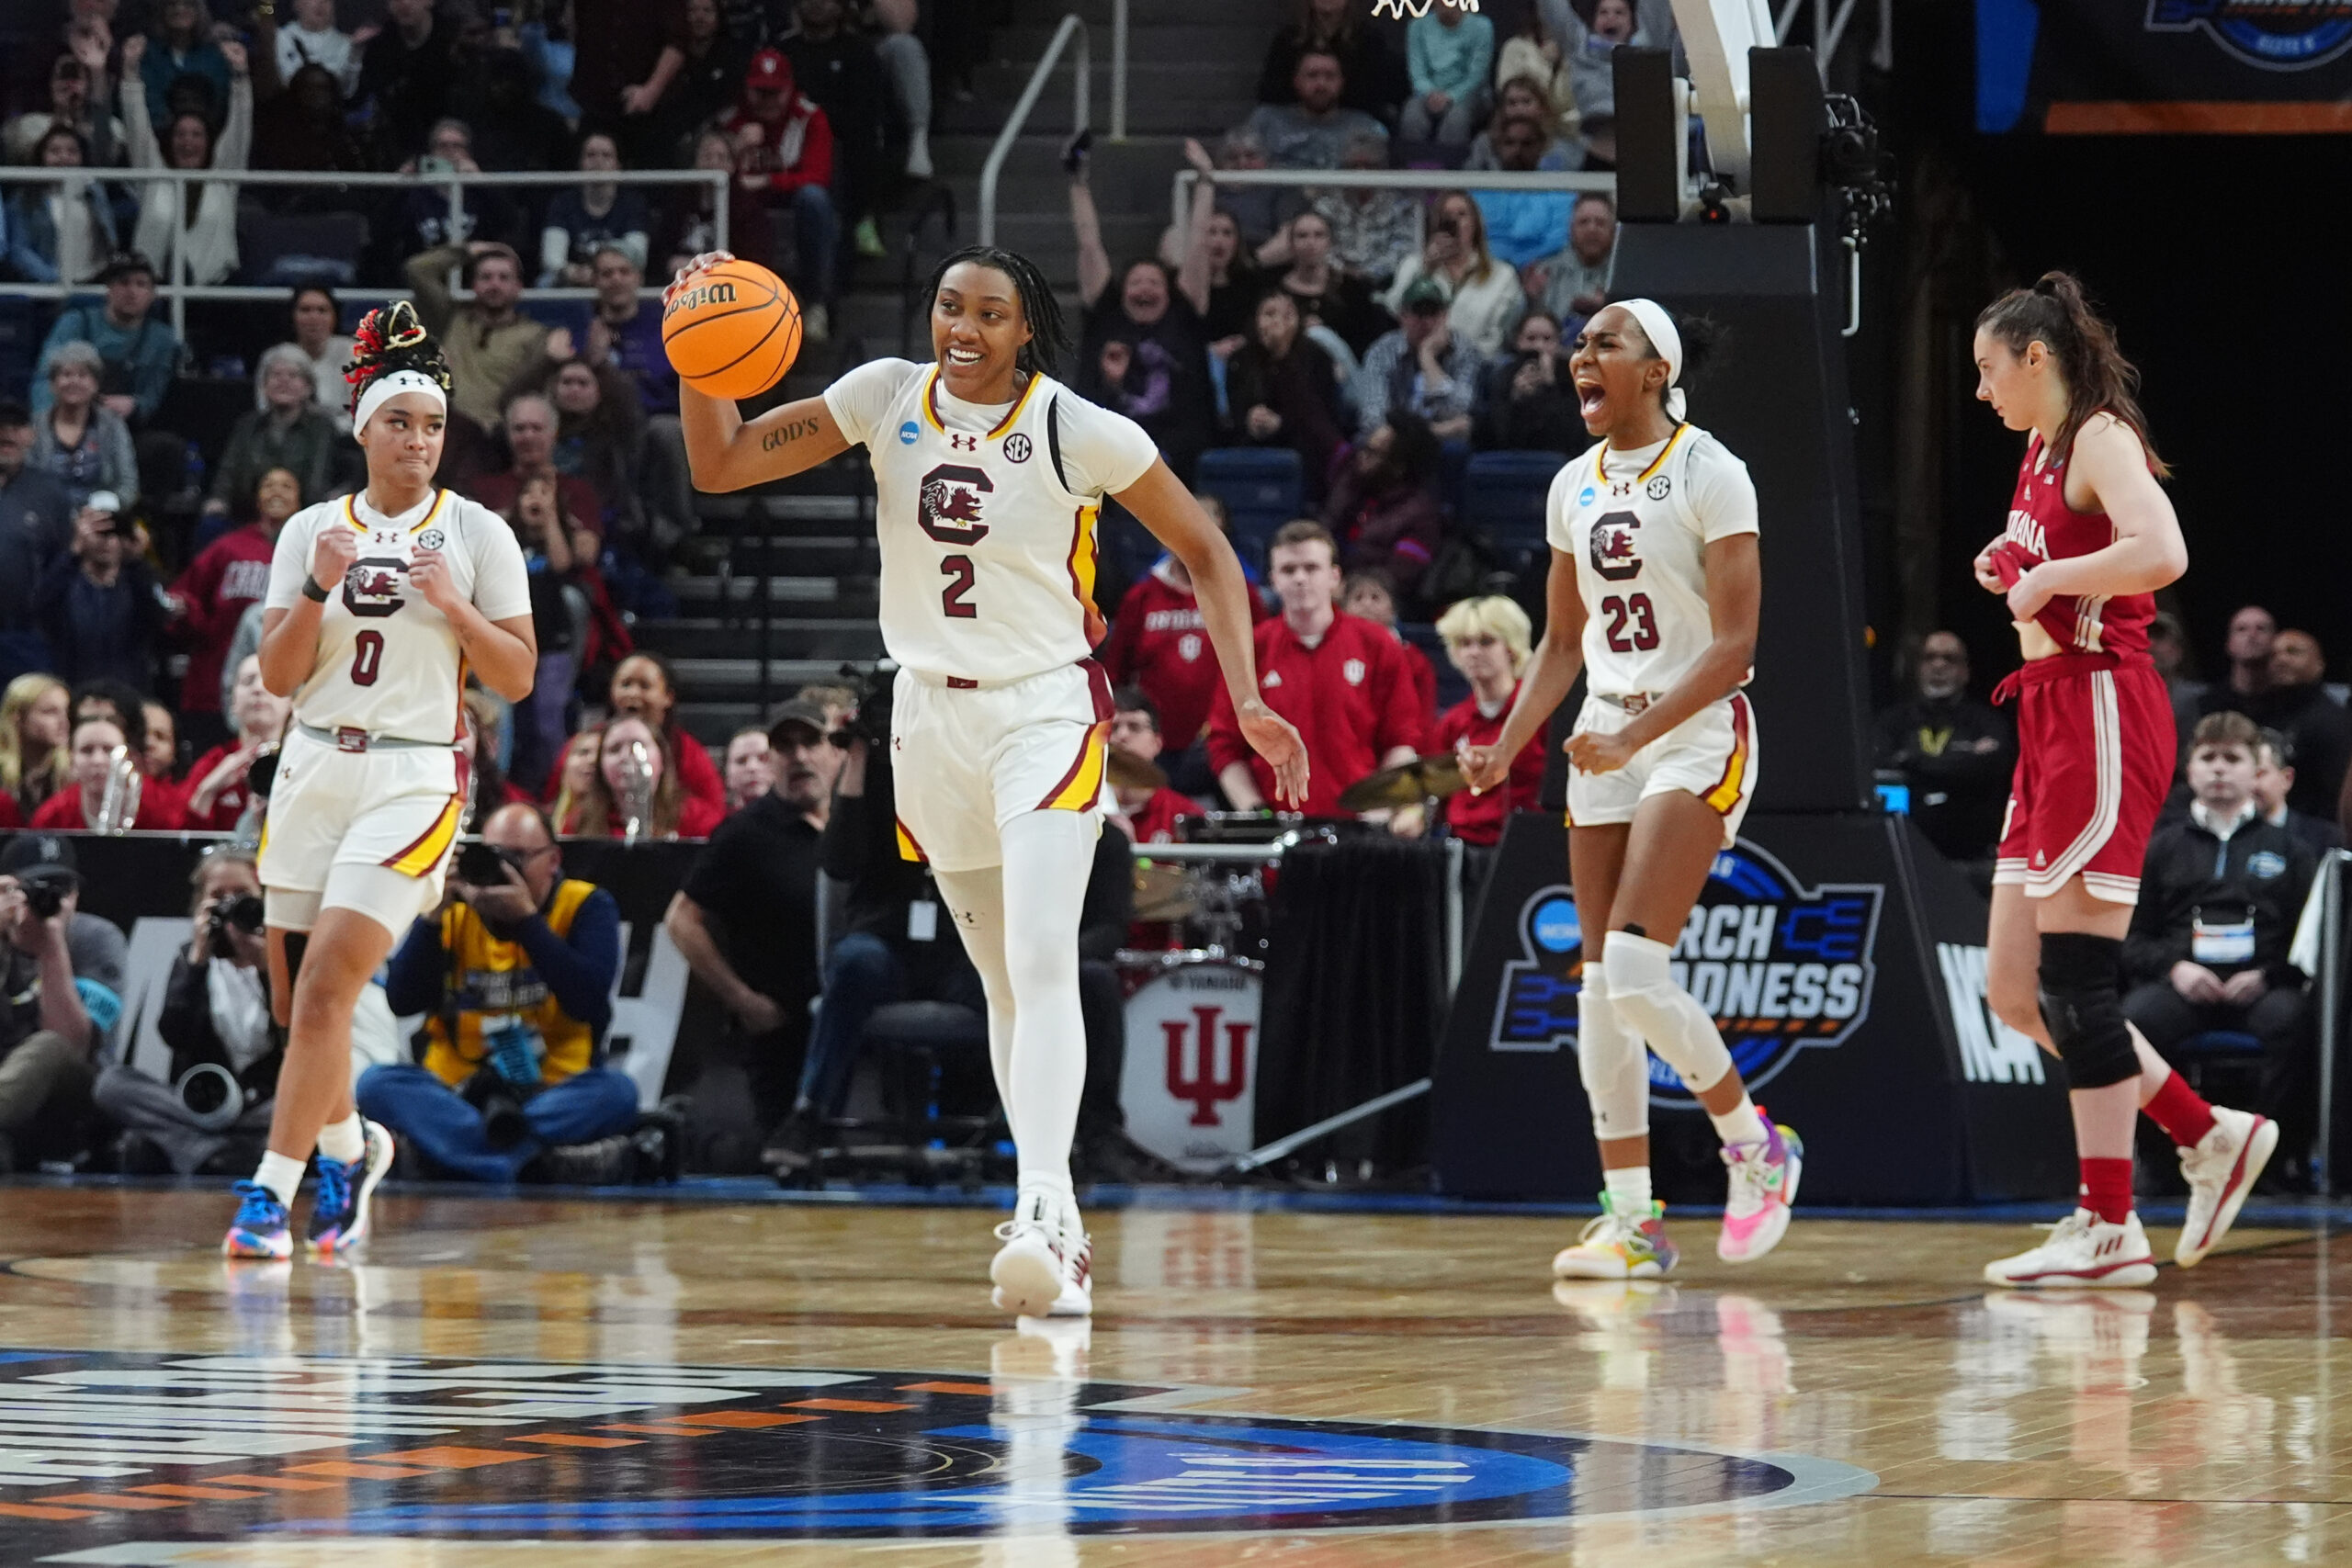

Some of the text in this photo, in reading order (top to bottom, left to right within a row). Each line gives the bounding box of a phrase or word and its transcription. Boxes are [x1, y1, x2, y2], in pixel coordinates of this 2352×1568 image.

[664, 282, 737, 321] Wilson
[763, 417, 820, 452] GOD'S
[1004, 434, 1031, 461] SEC
[940, 554, 978, 619] 2
[1601, 592, 1661, 653] 23
[350, 629, 385, 687] 0
[1670, 904, 1778, 960] RCH
[1670, 962, 1864, 1019] DNESS
[1160, 1005, 1253, 1127] IU
